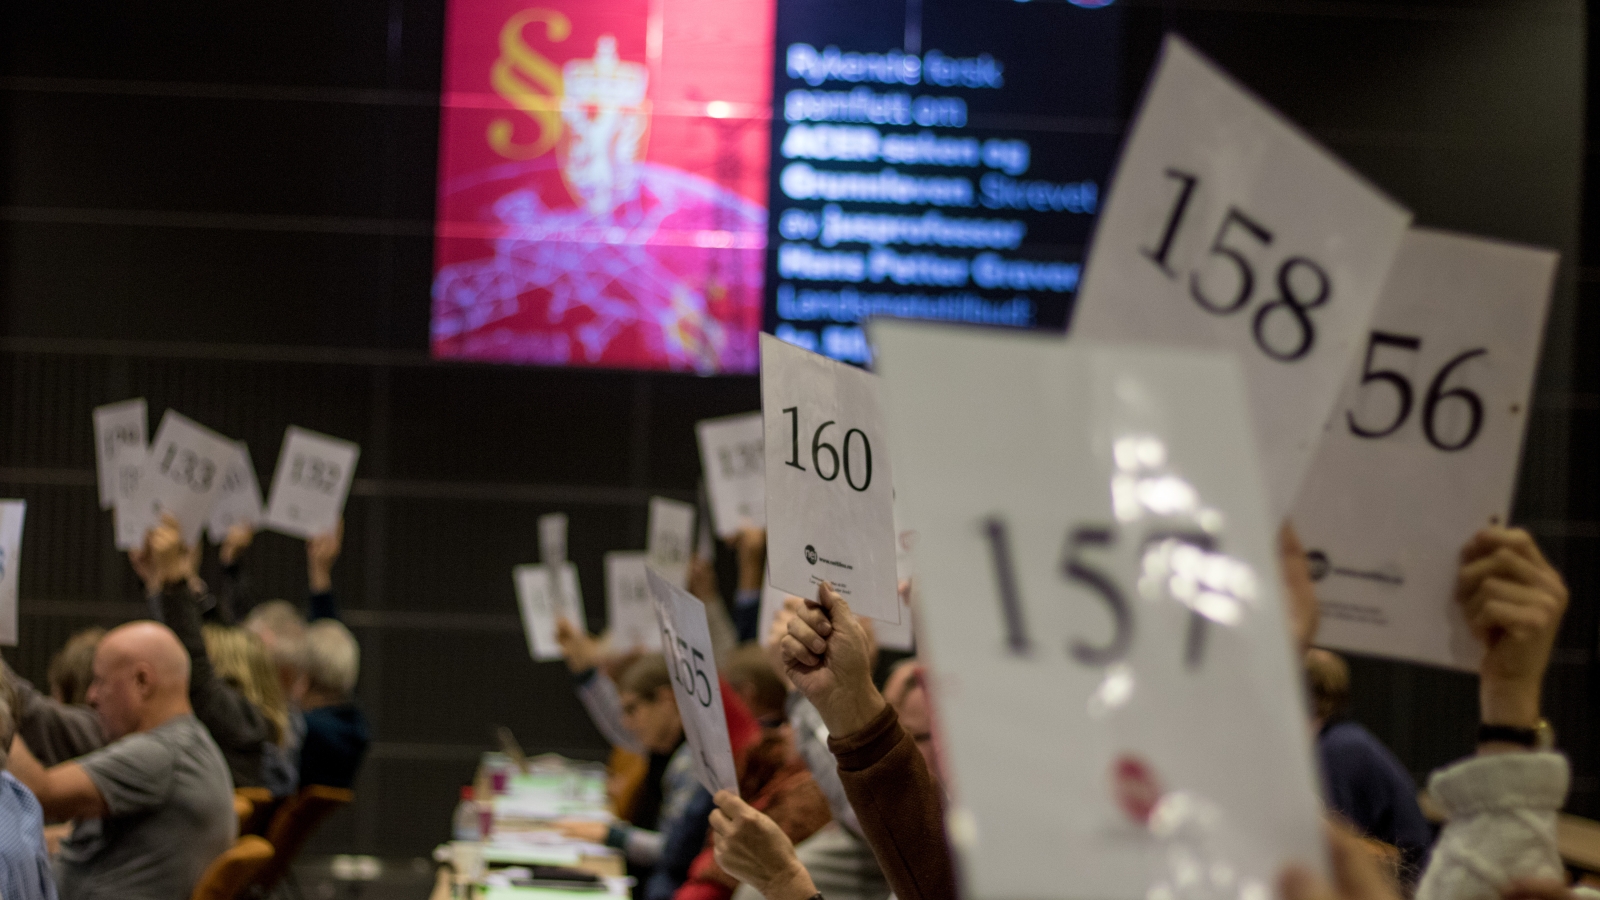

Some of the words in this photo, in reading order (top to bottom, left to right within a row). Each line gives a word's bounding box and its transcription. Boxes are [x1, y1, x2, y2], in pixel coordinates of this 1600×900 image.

[1139, 166, 1333, 364] 158
[1346, 330, 1488, 452] 56
[160, 441, 217, 494] 133
[782, 406, 873, 492] 160
[975, 512, 1224, 668] 157
[664, 628, 712, 707] 155
